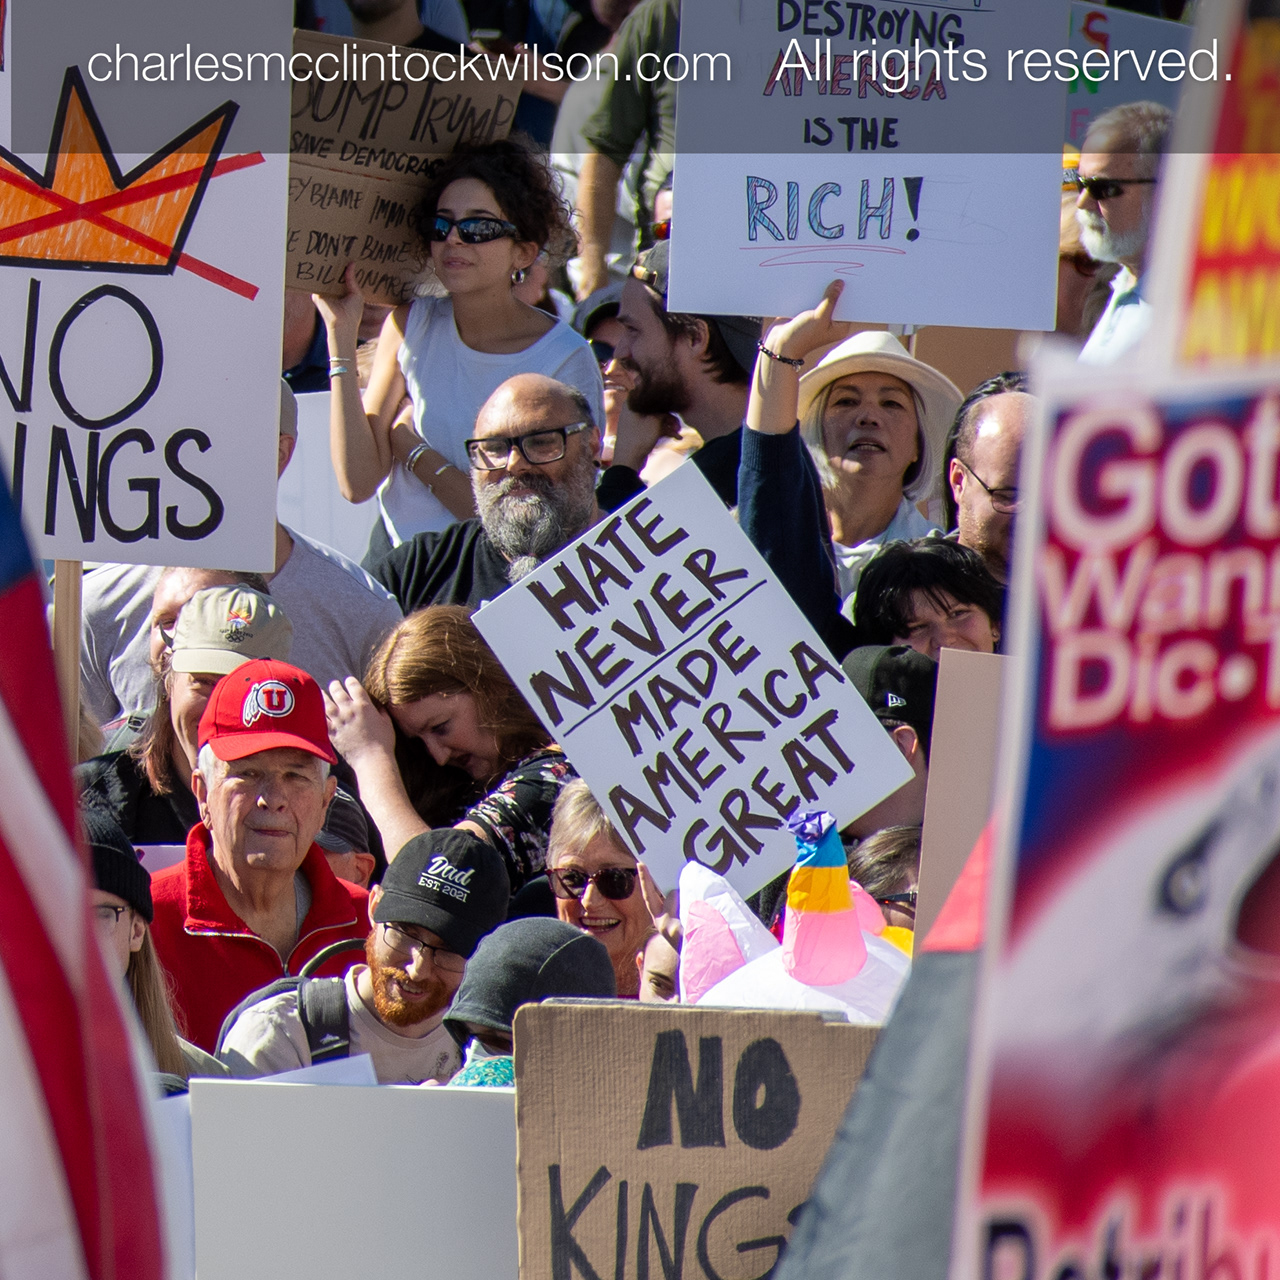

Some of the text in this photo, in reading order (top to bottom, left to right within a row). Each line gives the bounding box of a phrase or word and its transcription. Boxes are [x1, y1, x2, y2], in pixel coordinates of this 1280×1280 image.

[291, 69, 409, 142] DUMP
[763, 48, 948, 101] AMERICA
[289, 130, 334, 158] SAVE
[410, 76, 516, 150] TRUMP
[804, 116, 899, 149] IS THE
[288, 176, 312, 202] EY
[310, 183, 363, 210] BLAME
[746, 175, 925, 242] RICH!
[305, 230, 358, 258] DON'T
[360, 235, 411, 263] BLAME
[11, 421, 225, 545] INGS
[526, 497, 690, 631] HATE
[1034, 536, 1280, 636] Wan
[529, 548, 750, 727] NEVER
[261, 687, 288, 710] U
[609, 620, 761, 757] MADE
[608, 640, 846, 854] AMERICA
[682, 708, 856, 876] GREAT
[418, 875, 468, 903] EST. 2021
[428, 855, 475, 888] Dad
[636, 1027, 802, 1151] NO
[548, 1164, 810, 1280] KING
